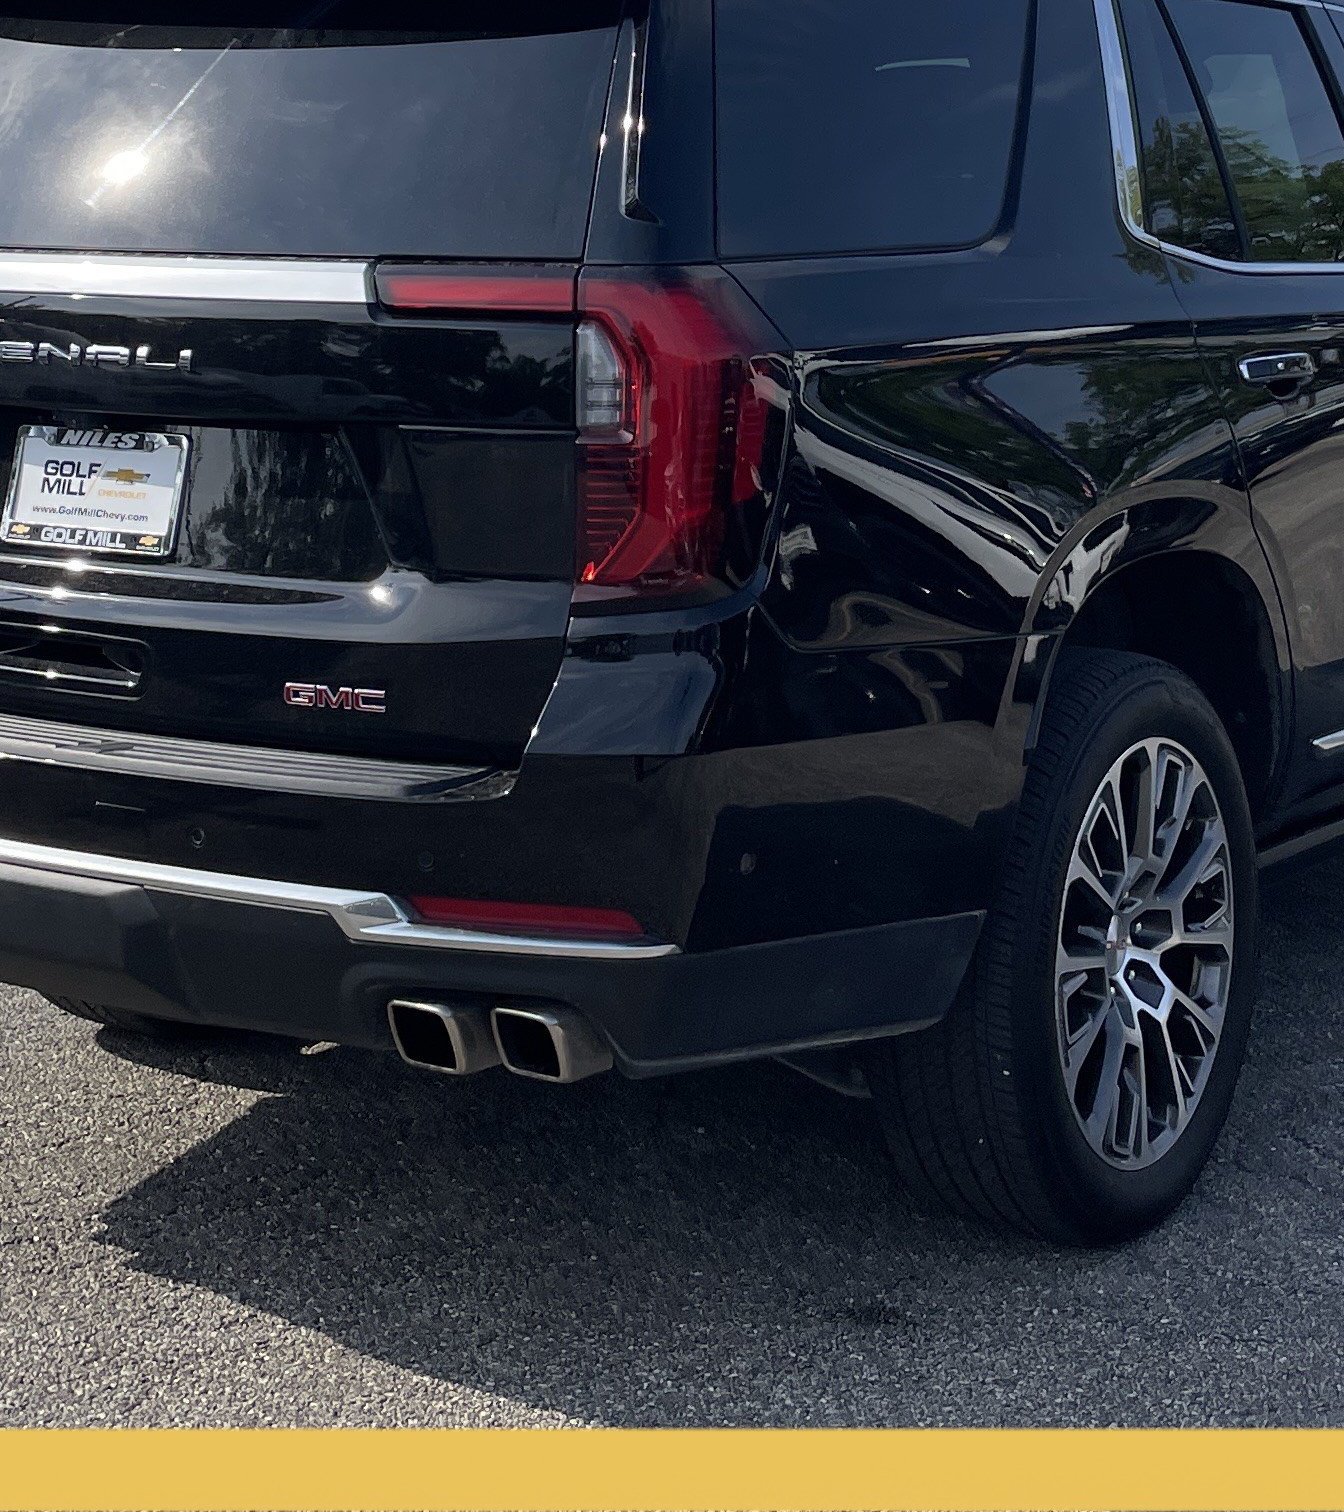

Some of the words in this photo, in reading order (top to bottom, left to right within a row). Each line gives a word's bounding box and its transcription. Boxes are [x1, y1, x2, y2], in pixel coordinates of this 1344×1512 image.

[61, 429, 140, 450] NILES
[44, 459, 102, 479] GOLF
[41, 477, 86, 496] MILL
[97, 489, 148, 500] CHEVROLET
[32, 504, 149, 522] www.GolfMillChevy.com
[40, 526, 86, 545] GOLF
[86, 531, 126, 549] MILL
[283, 681, 386, 713] GMC
